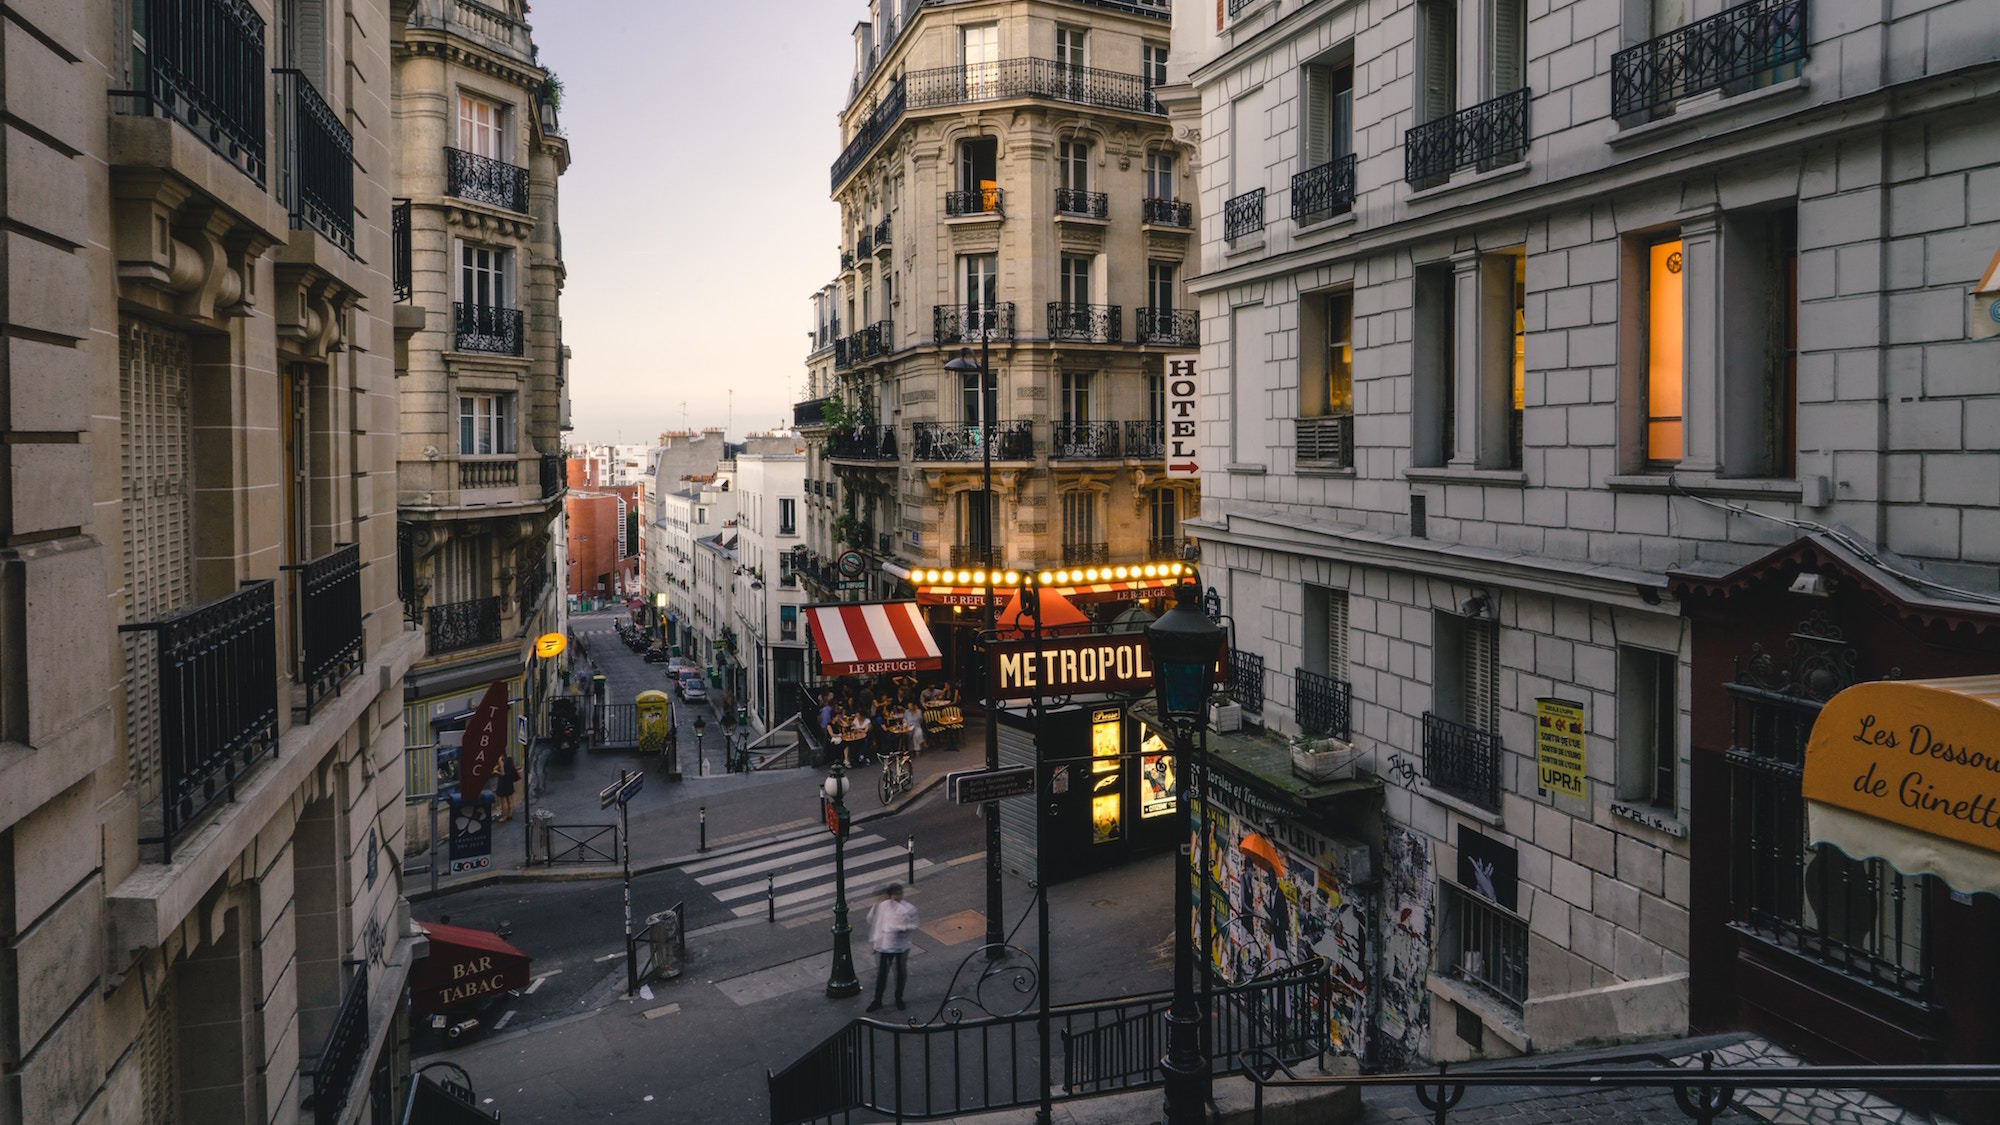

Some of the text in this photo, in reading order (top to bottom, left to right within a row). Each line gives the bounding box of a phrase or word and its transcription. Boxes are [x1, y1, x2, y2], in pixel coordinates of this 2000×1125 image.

[1169, 359, 1197, 457] HOTEL
[943, 595, 1003, 606] LE REFUE
[1116, 588, 1166, 600] LE REFUGE
[848, 661, 917, 674] LE REFUGE
[471, 704, 499, 777] TABAC
[1853, 714, 2000, 773] Les Dessou
[1542, 767, 1581, 793] UPR.fr
[1853, 762, 1889, 798] de
[453, 857, 489, 872] LOTO
[452, 955, 493, 981] BAR
[440, 974, 505, 1005] TABAC
